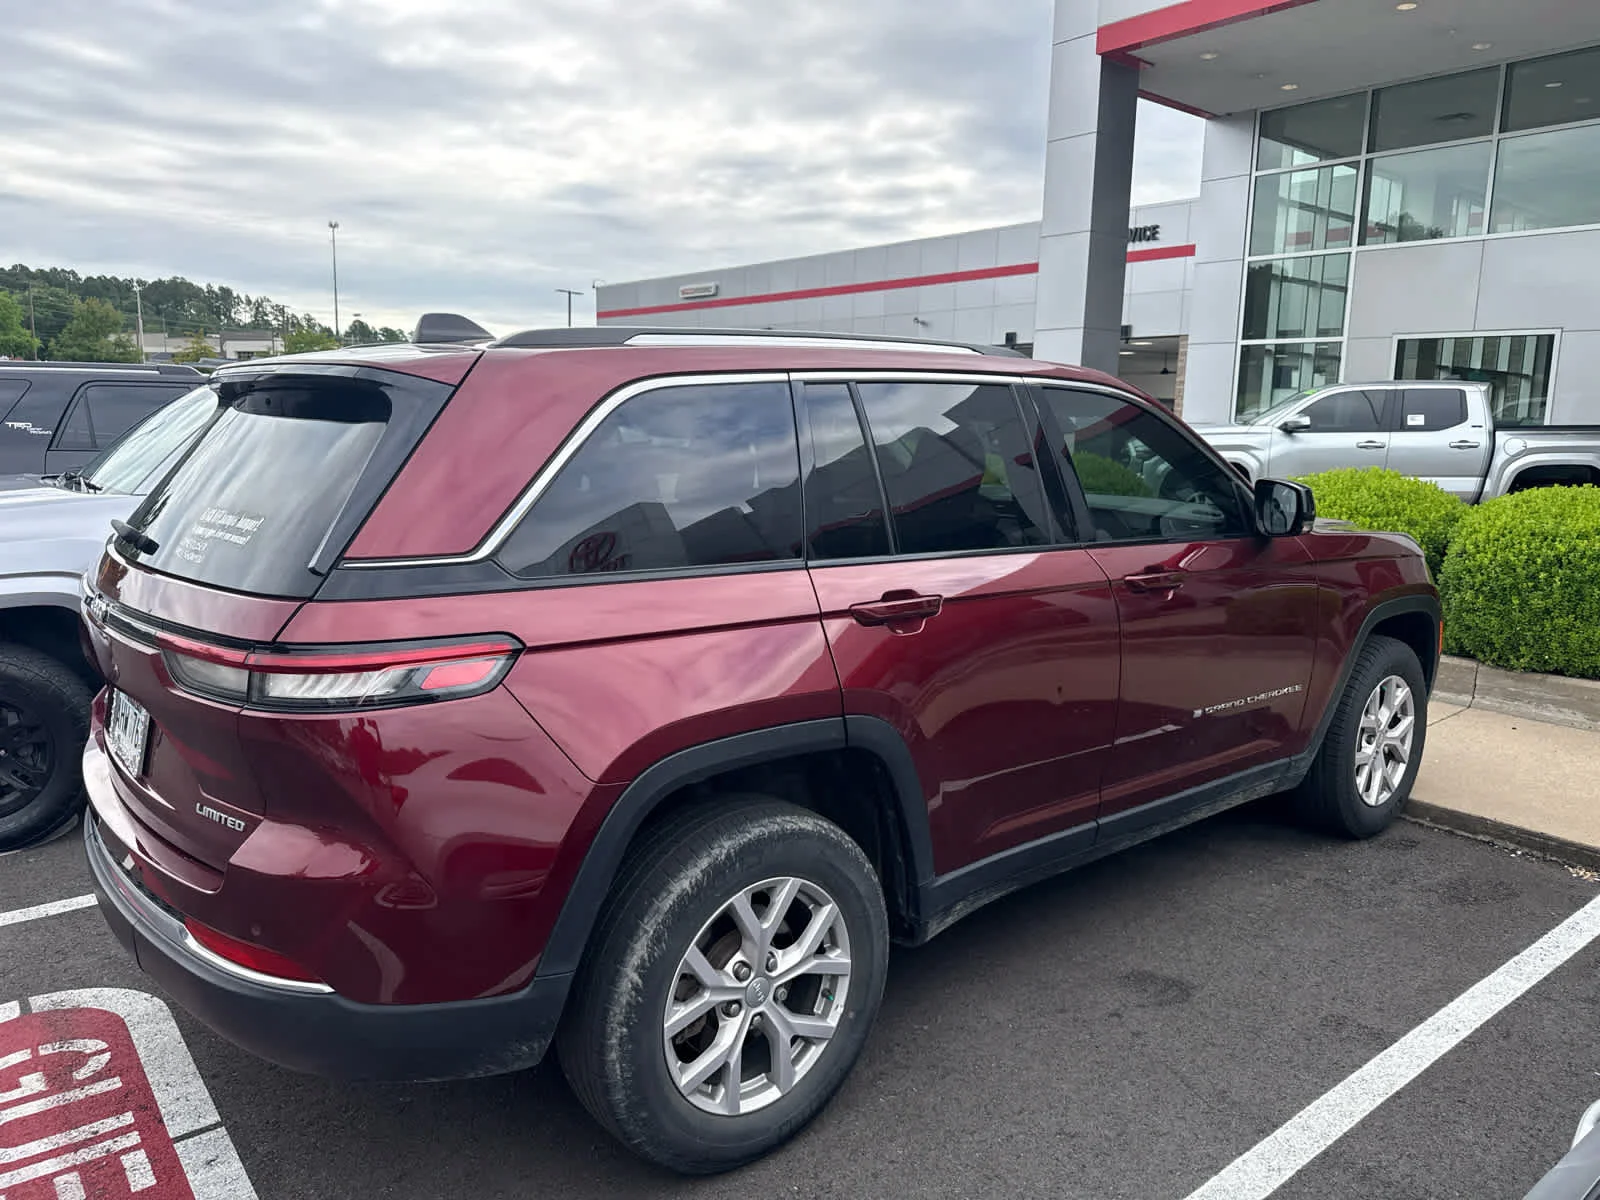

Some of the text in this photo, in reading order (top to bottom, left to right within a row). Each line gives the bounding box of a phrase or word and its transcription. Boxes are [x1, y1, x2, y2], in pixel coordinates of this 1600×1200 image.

[1204, 683, 1303, 714] GRAND CHEROKEE
[195, 802, 246, 832] LIMITED
